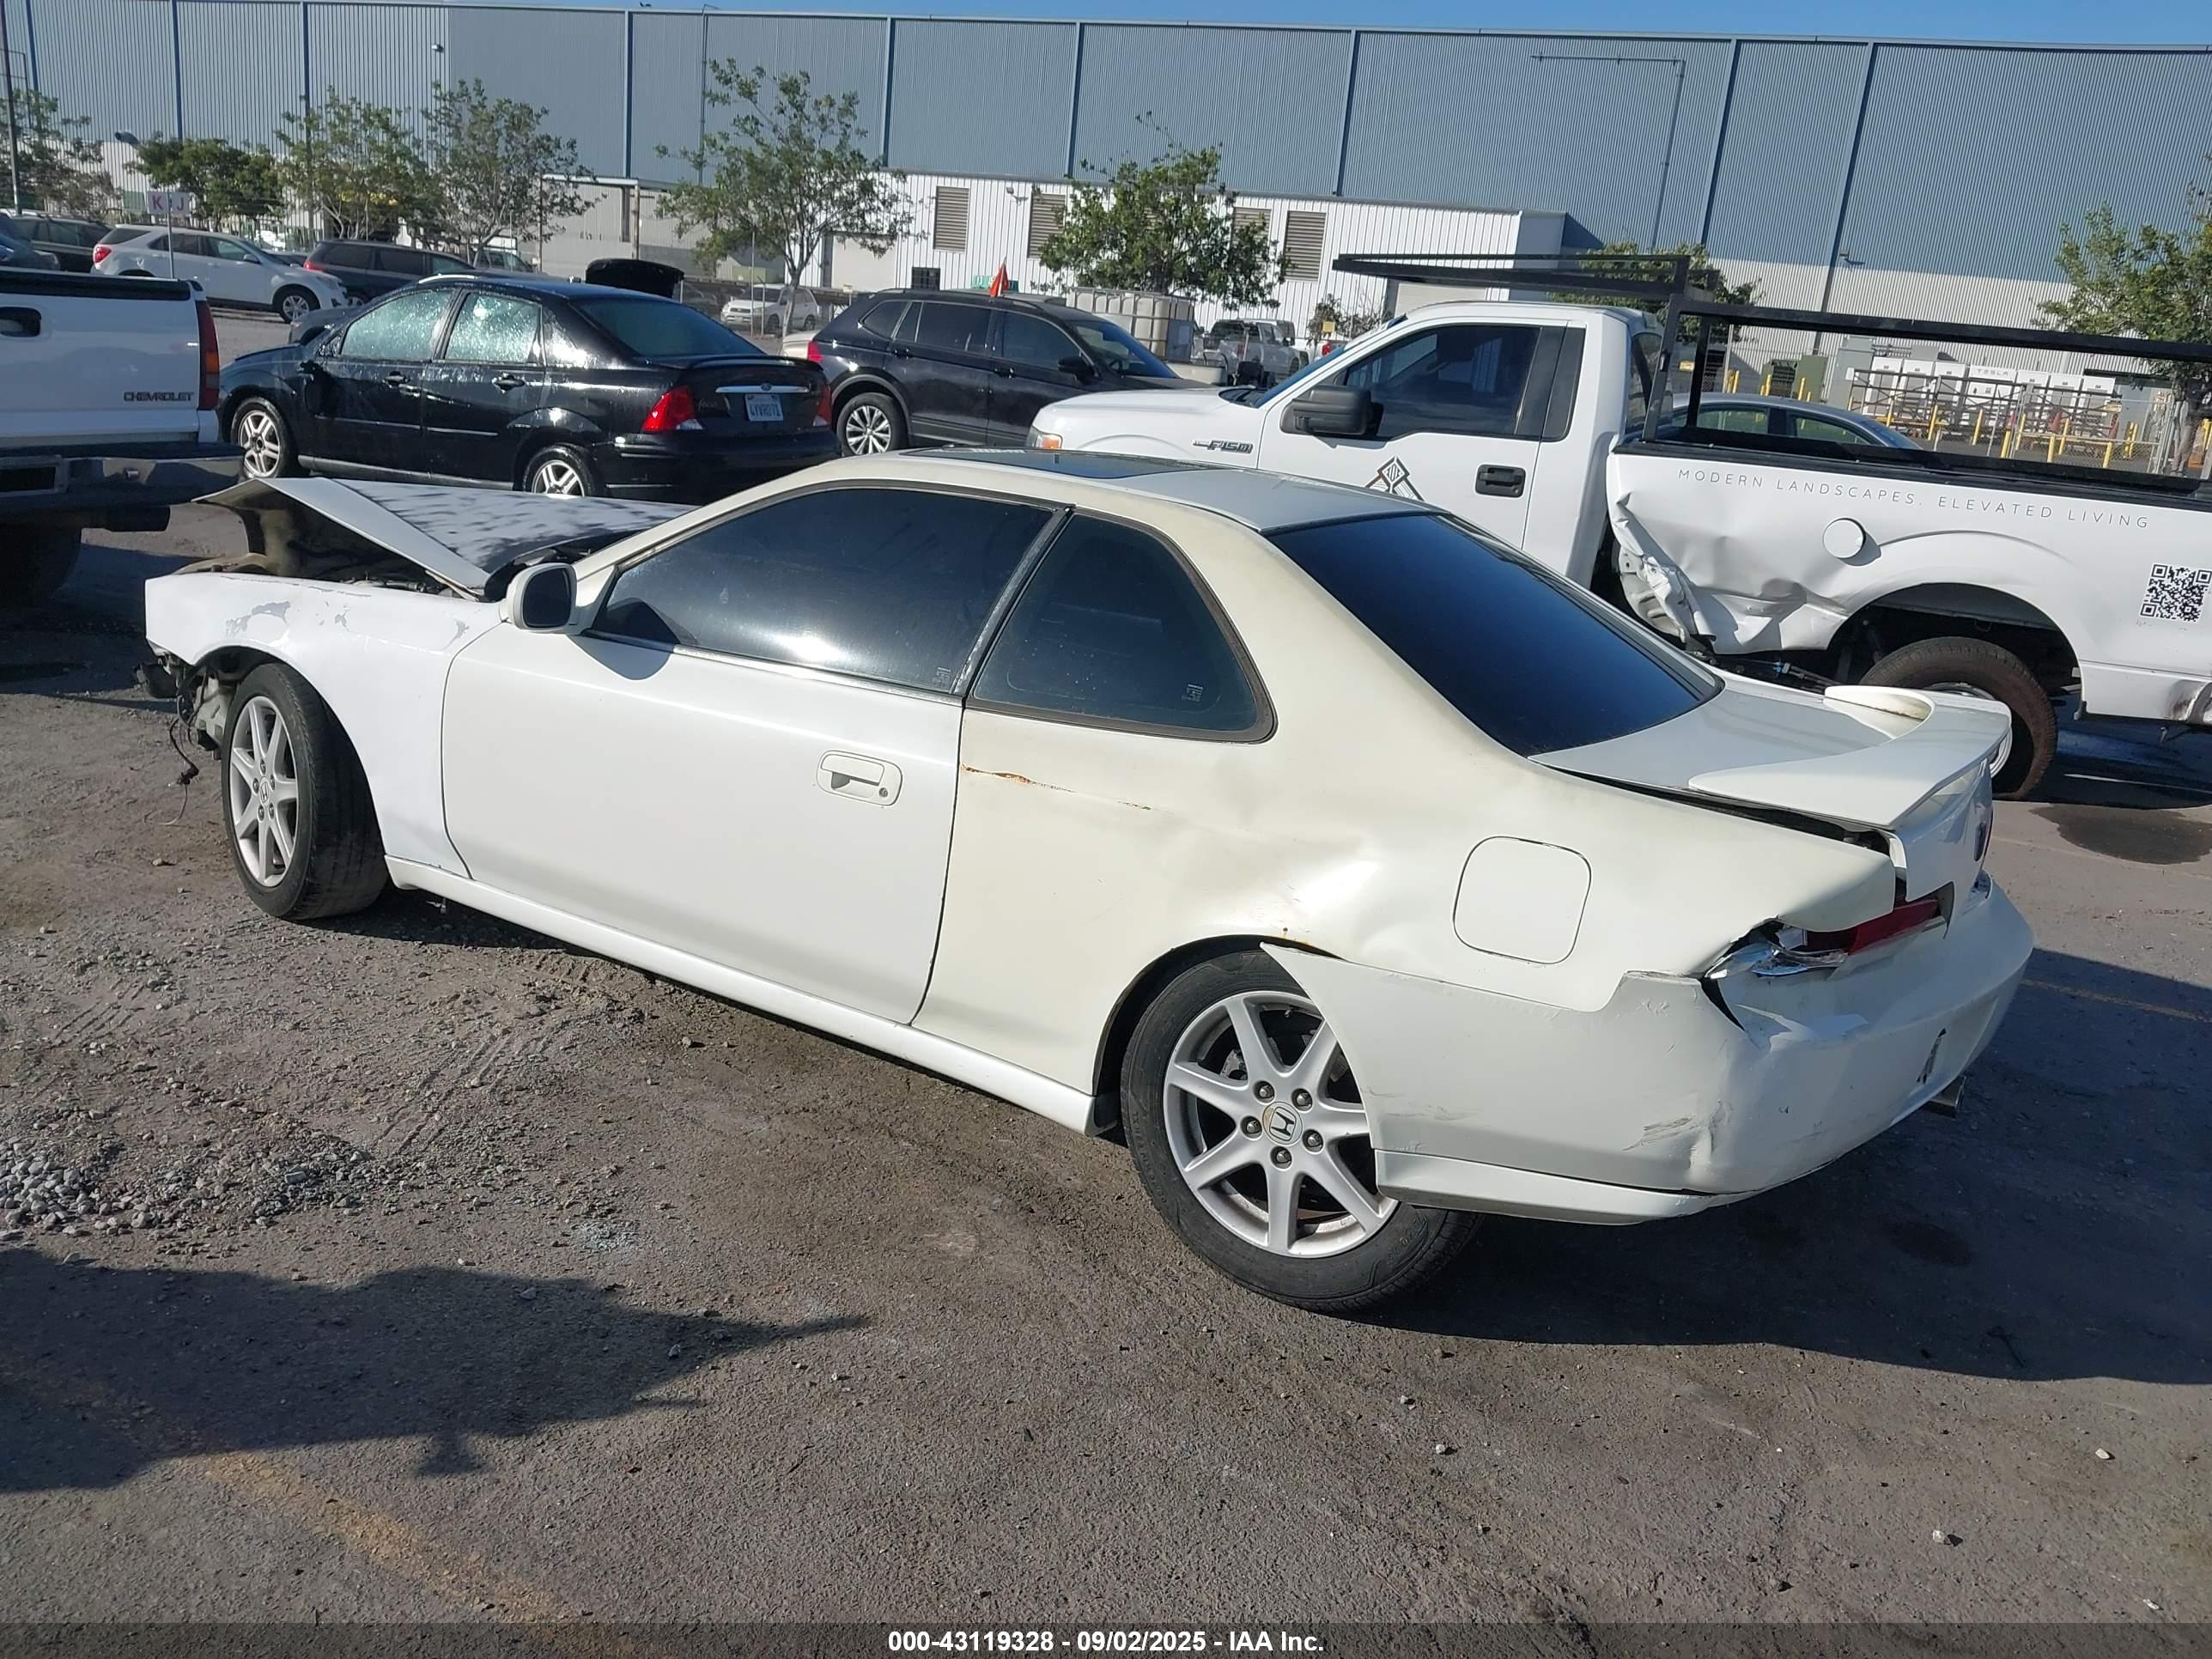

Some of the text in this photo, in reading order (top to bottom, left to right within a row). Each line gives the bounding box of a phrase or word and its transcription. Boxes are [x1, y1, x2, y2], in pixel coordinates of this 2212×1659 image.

[152, 195, 184, 211] K J
[123, 391, 194, 401] CHEVROLET
[1678, 469, 2148, 529] MODERN LANDSCAPES. ELEVATED LIVING
